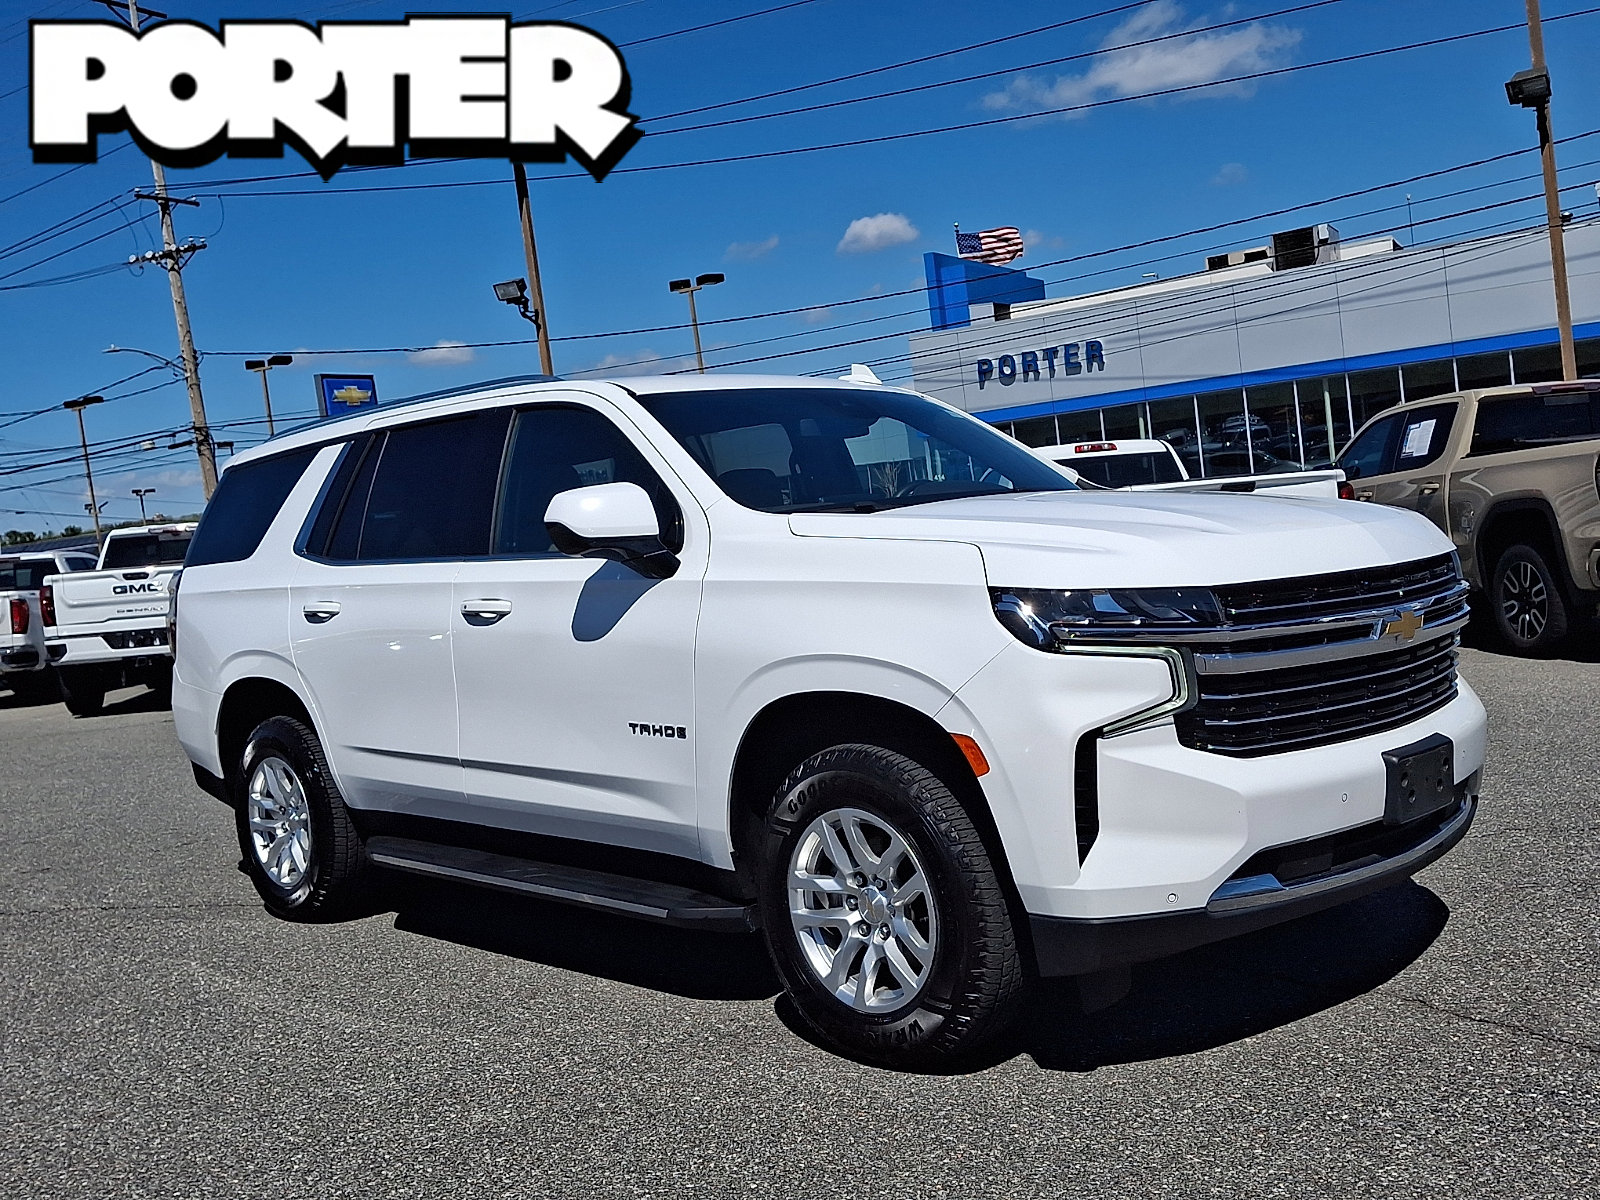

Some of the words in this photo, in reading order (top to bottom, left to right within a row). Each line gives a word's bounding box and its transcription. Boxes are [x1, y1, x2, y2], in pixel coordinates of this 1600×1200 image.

[977, 340, 1105, 388] PORTER
[113, 582, 162, 595] GMC
[628, 722, 687, 739] TAHOE
